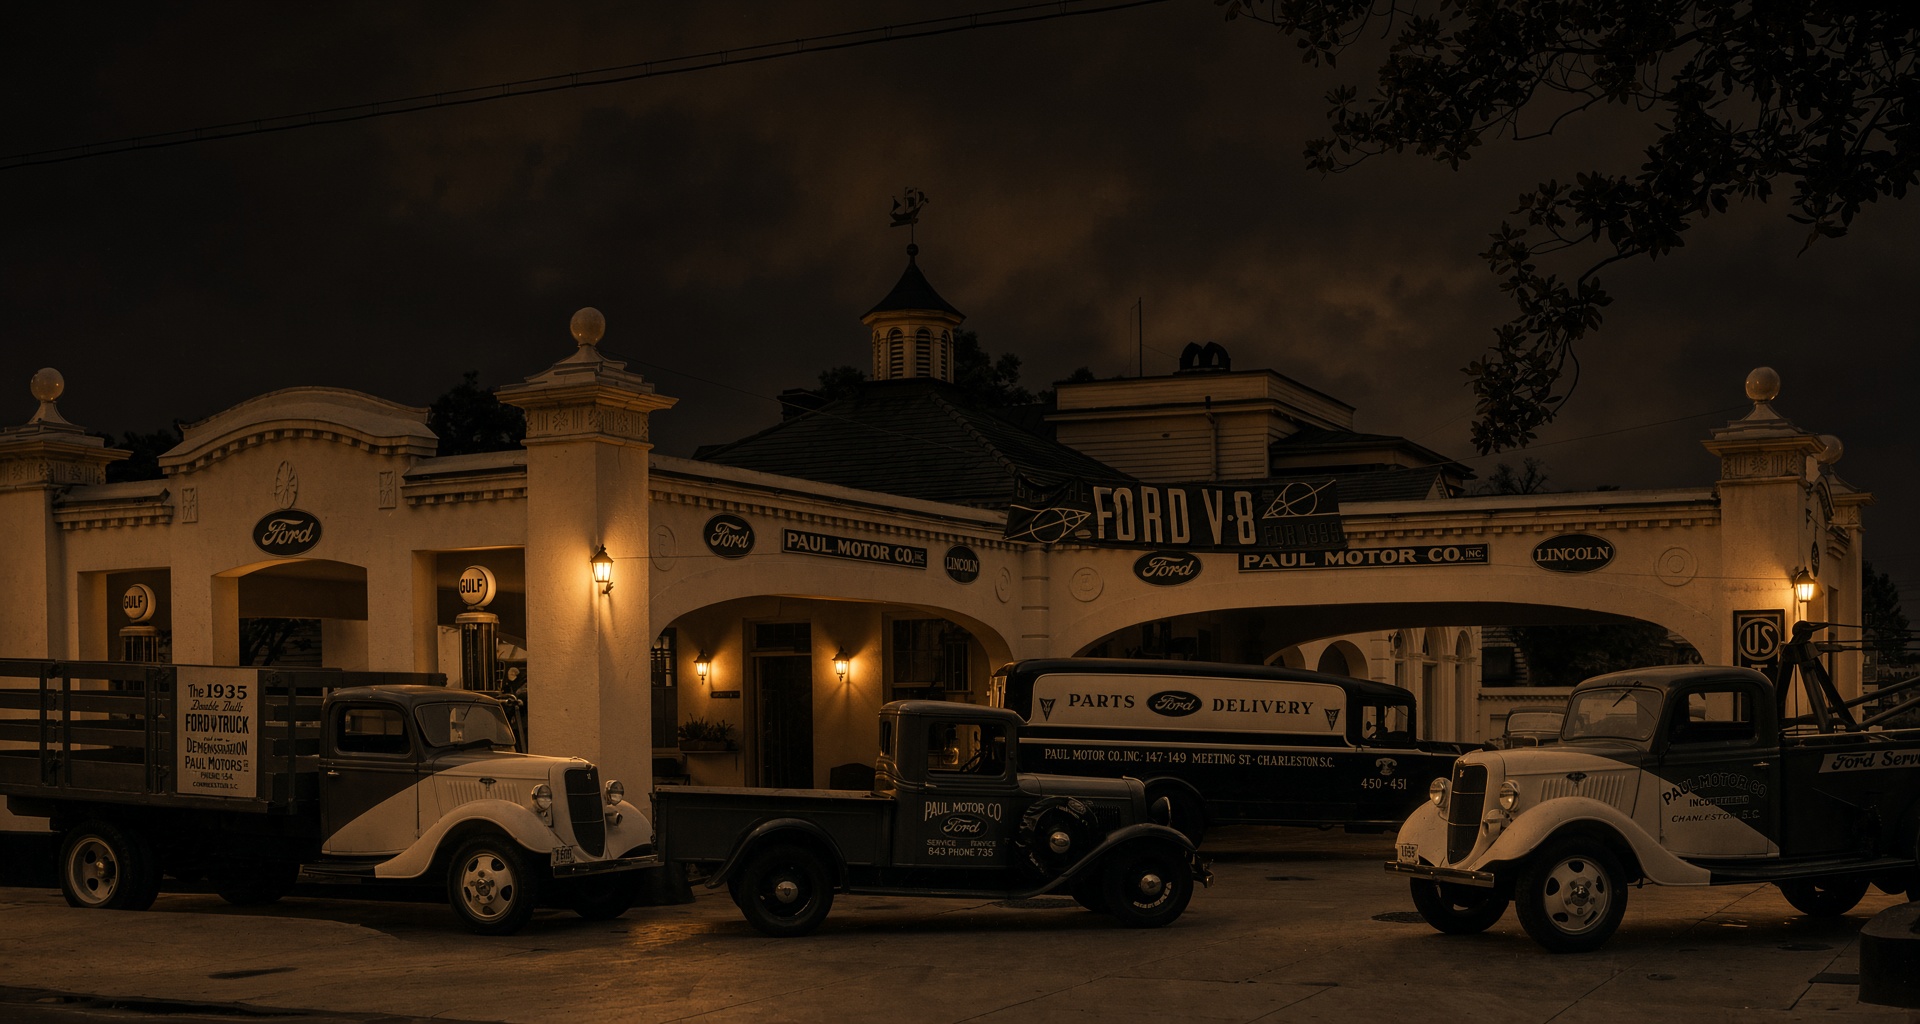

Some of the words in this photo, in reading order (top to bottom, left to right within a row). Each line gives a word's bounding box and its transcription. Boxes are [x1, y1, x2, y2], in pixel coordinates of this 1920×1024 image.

[1093, 486, 1190, 544] FORD
[262, 518, 313, 545] Ford
[710, 522, 749, 549] Ford
[787, 532, 832, 553] PAUL
[837, 539, 890, 561] MOTOR
[1536, 547, 1611, 562] LINCOLN
[946, 556, 979, 573] LINCOLN
[1143, 557, 1194, 579] Ford
[1243, 551, 1316, 569] PAUL
[1324, 548, 1418, 567] MOTOR
[460, 578, 483, 594] GULF
[123, 595, 143, 609] GULF
[1746, 624, 1774, 654] US
[188, 684, 204, 698] The
[206, 683, 247, 699] 1935
[1068, 693, 1136, 709] PARTS
[1154, 694, 1196, 711] Ford
[1212, 698, 1314, 716] DELIVERY
[186, 714, 209, 732] FORD
[218, 715, 249, 734] TRUCK
[185, 756, 206, 770] PAUL
[208, 757, 243, 771] MOTORS
[1044, 748, 1070, 760] PAUL
[1073, 750, 1105, 761] MOTOR
[1145, 751, 1187, 763] 147-149
[1192, 753, 1236, 765] MEETING
[1257, 755, 1319, 767] CHARLESTON
[1832, 753, 1876, 770] Ford
[1881, 751, 1920, 766] Serv
[1662, 779, 1698, 805] PAUL
[1698, 772, 1748, 791] MOTOR
[1750, 779, 1768, 798] CO
[924, 800, 951, 822] PAUL
[953, 802, 985, 815] MOTOR
[943, 817, 982, 833] Ford
[928, 847, 946, 856] 843
[948, 848, 975, 857] PHONE
[977, 848, 994, 857] 735
